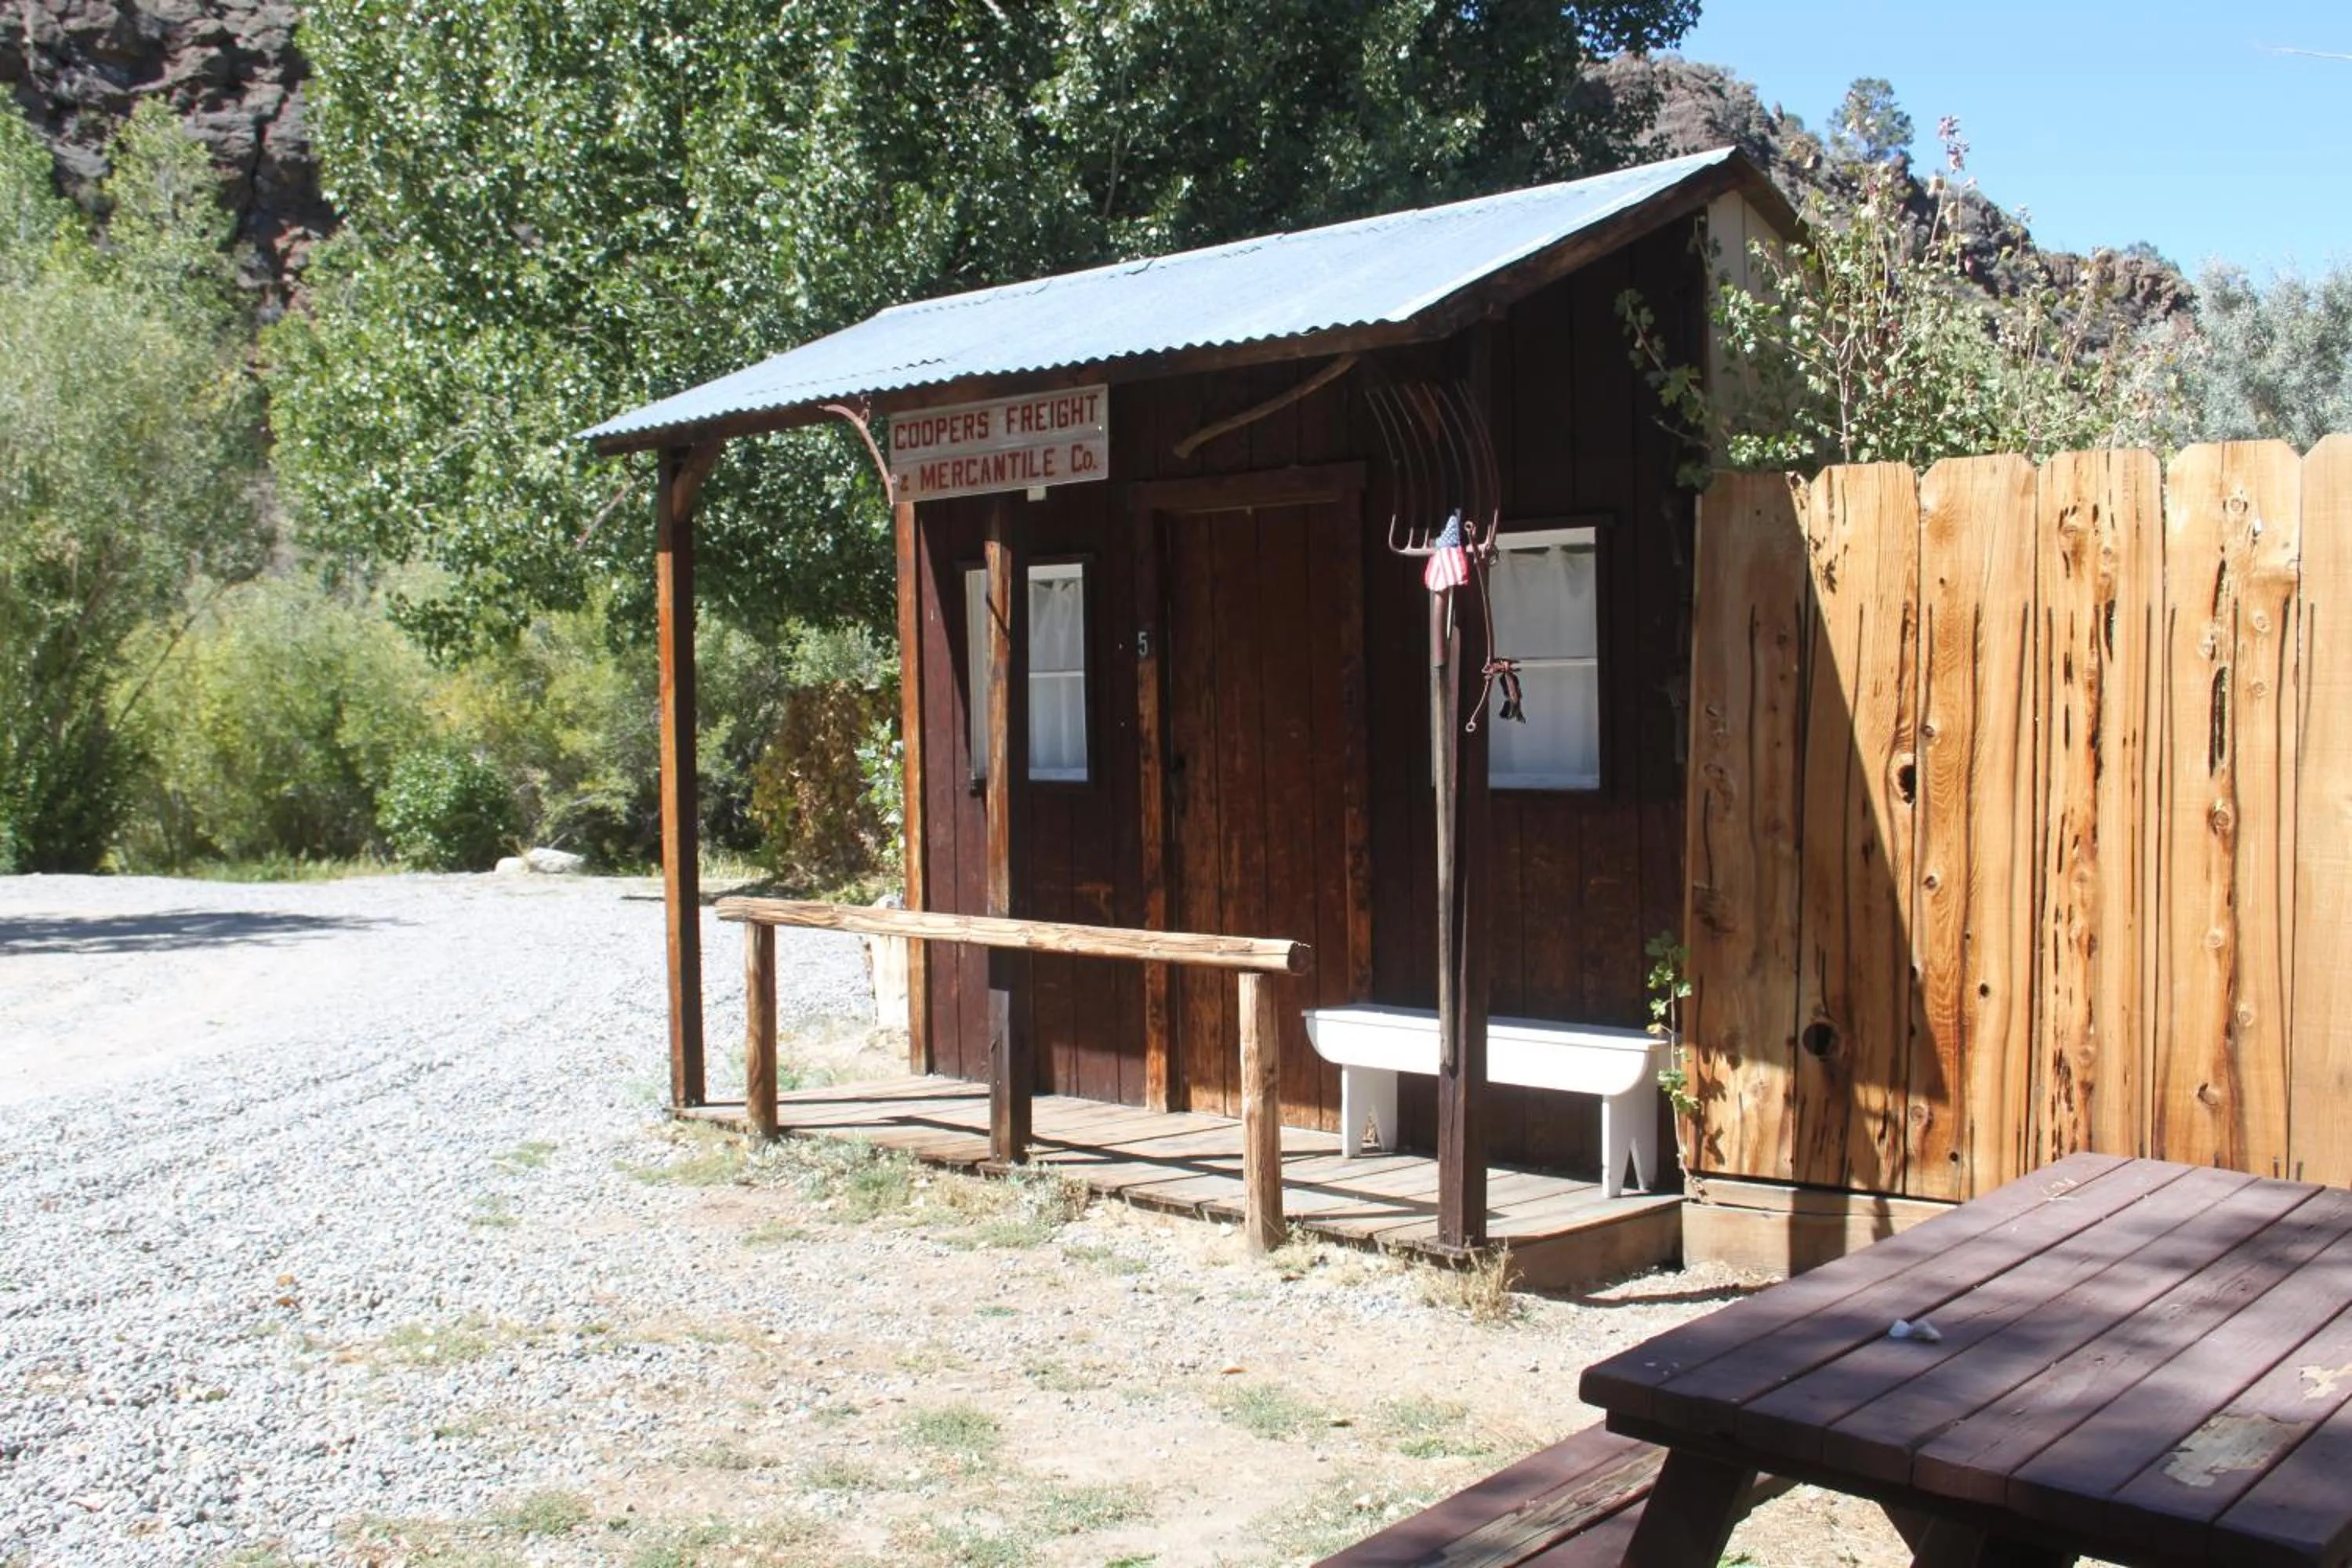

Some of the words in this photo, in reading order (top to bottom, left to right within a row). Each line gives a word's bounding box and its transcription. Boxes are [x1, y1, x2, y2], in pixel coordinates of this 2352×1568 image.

[895, 412, 989, 451] COOPERS
[1006, 394, 1098, 435] FREIGHT
[920, 448, 1055, 491] MERCANTILE
[1071, 444, 1098, 473] Co.
[1138, 631, 1148, 656] 5
